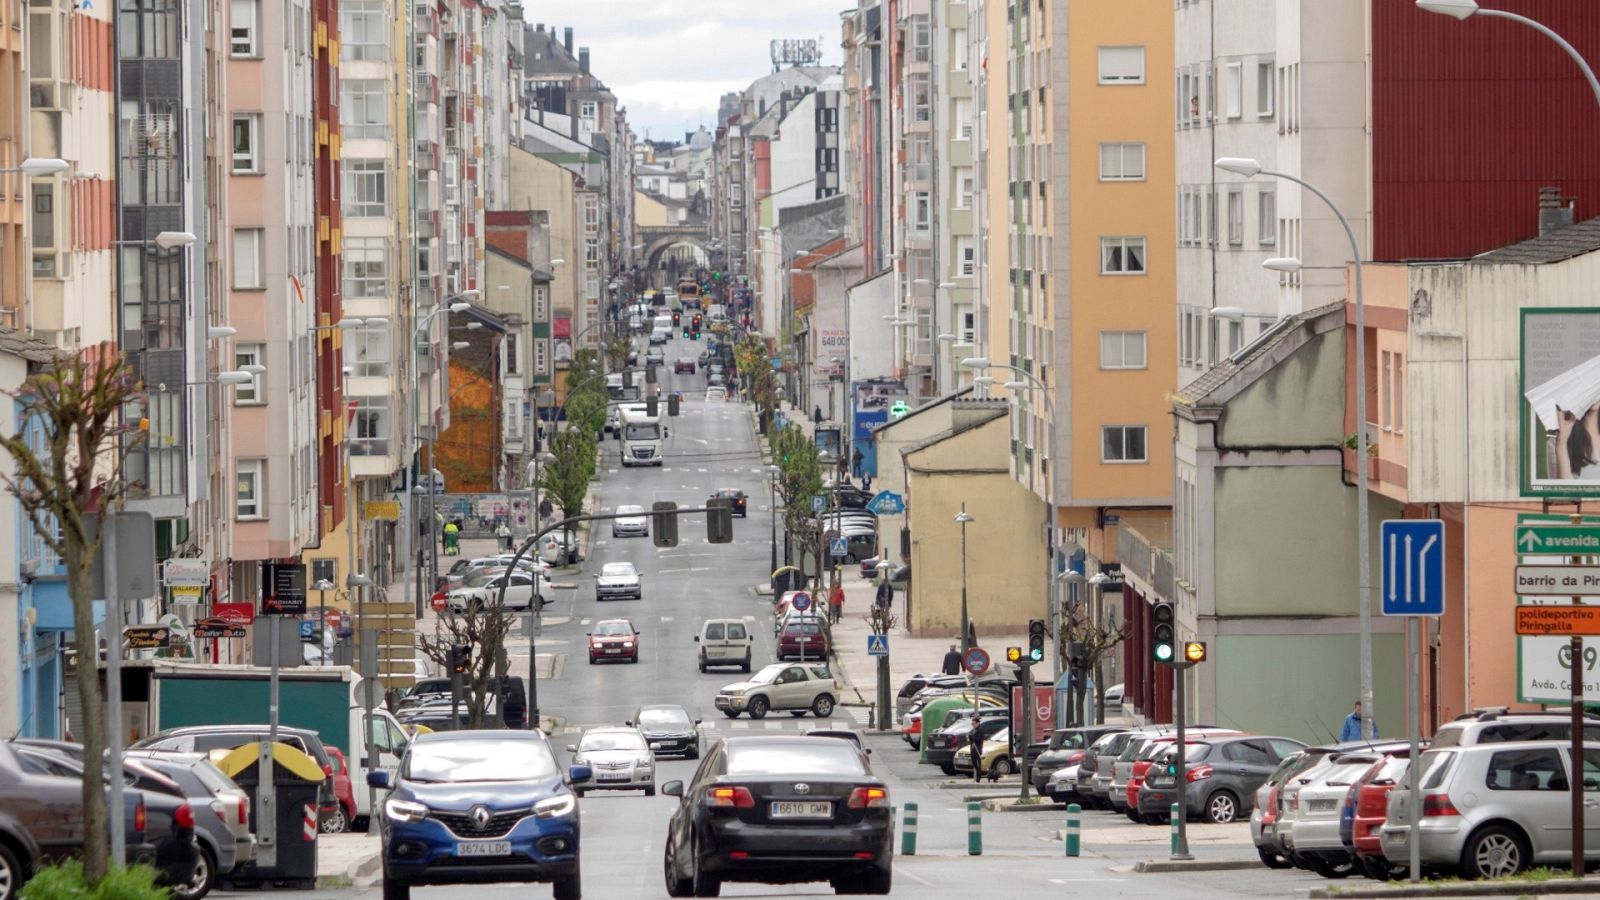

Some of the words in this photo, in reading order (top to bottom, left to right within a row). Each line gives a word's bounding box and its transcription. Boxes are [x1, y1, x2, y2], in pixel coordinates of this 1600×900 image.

[822, 336, 836, 346] 648
[1545, 534, 1600, 546] avenida
[1519, 575, 1556, 586] barrio
[1562, 575, 1577, 586] da
[1583, 575, 1600, 586] Pir
[1519, 609, 1594, 620] polideportivo
[1519, 621, 1573, 633] Piringalla
[780, 803, 804, 814] 6610
[459, 843, 486, 854] 3674
